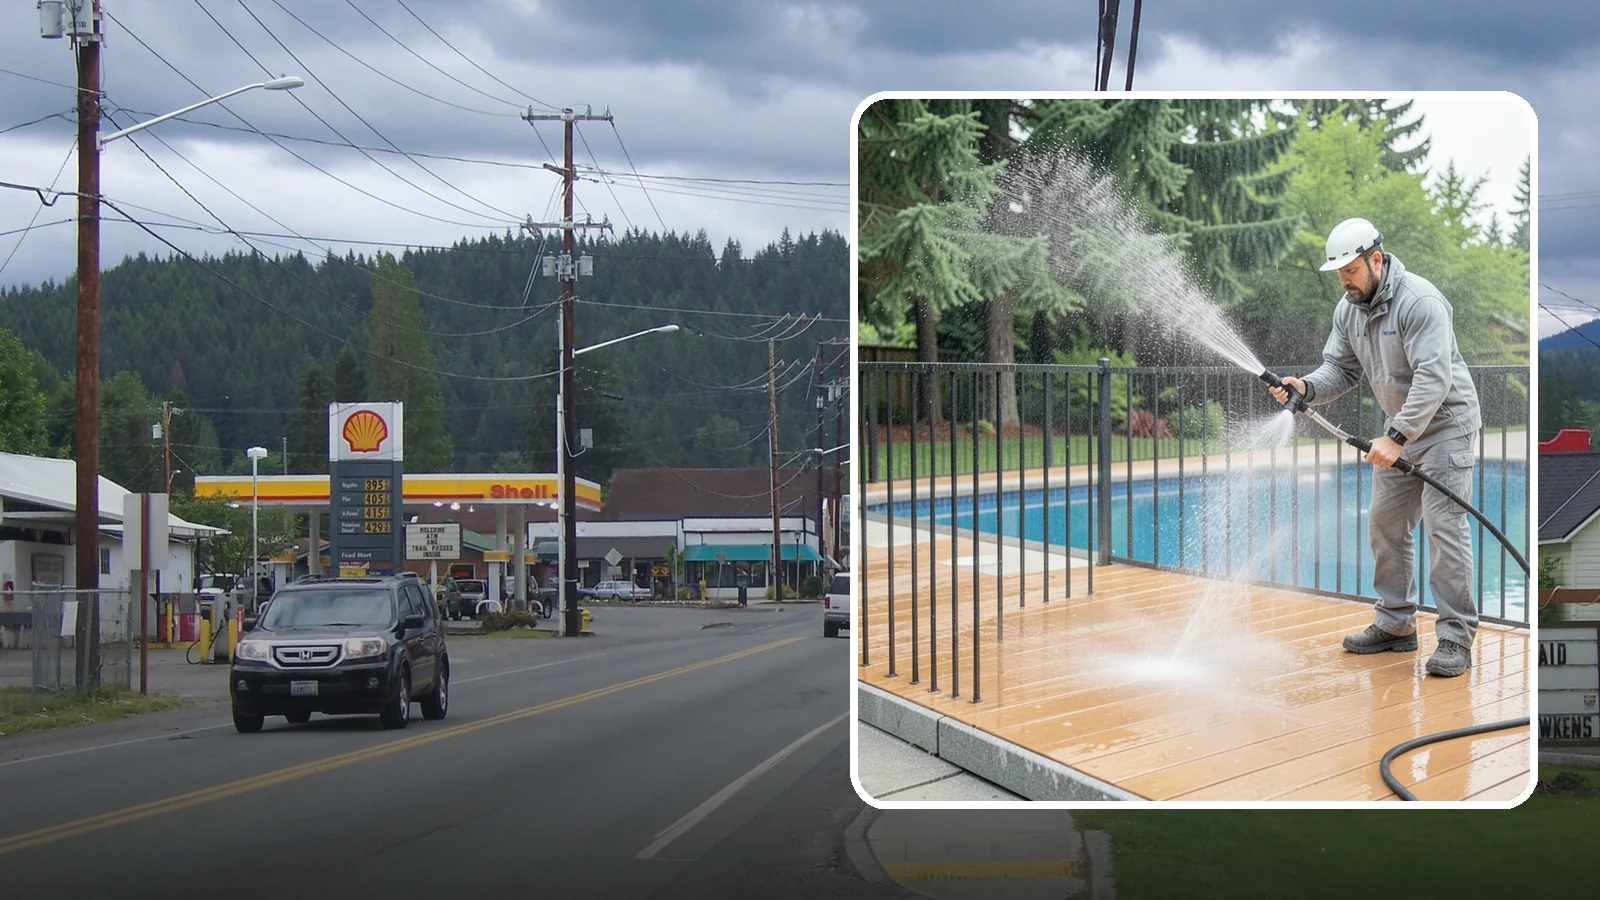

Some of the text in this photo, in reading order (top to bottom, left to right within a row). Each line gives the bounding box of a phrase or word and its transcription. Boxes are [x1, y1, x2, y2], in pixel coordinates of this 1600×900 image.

[365, 480, 384, 490] 395
[490, 484, 547, 499] Shell
[365, 494, 384, 504] 405
[365, 508, 384, 518] 415
[365, 522, 384, 533] 429
[1539, 643, 1567, 665] AID
